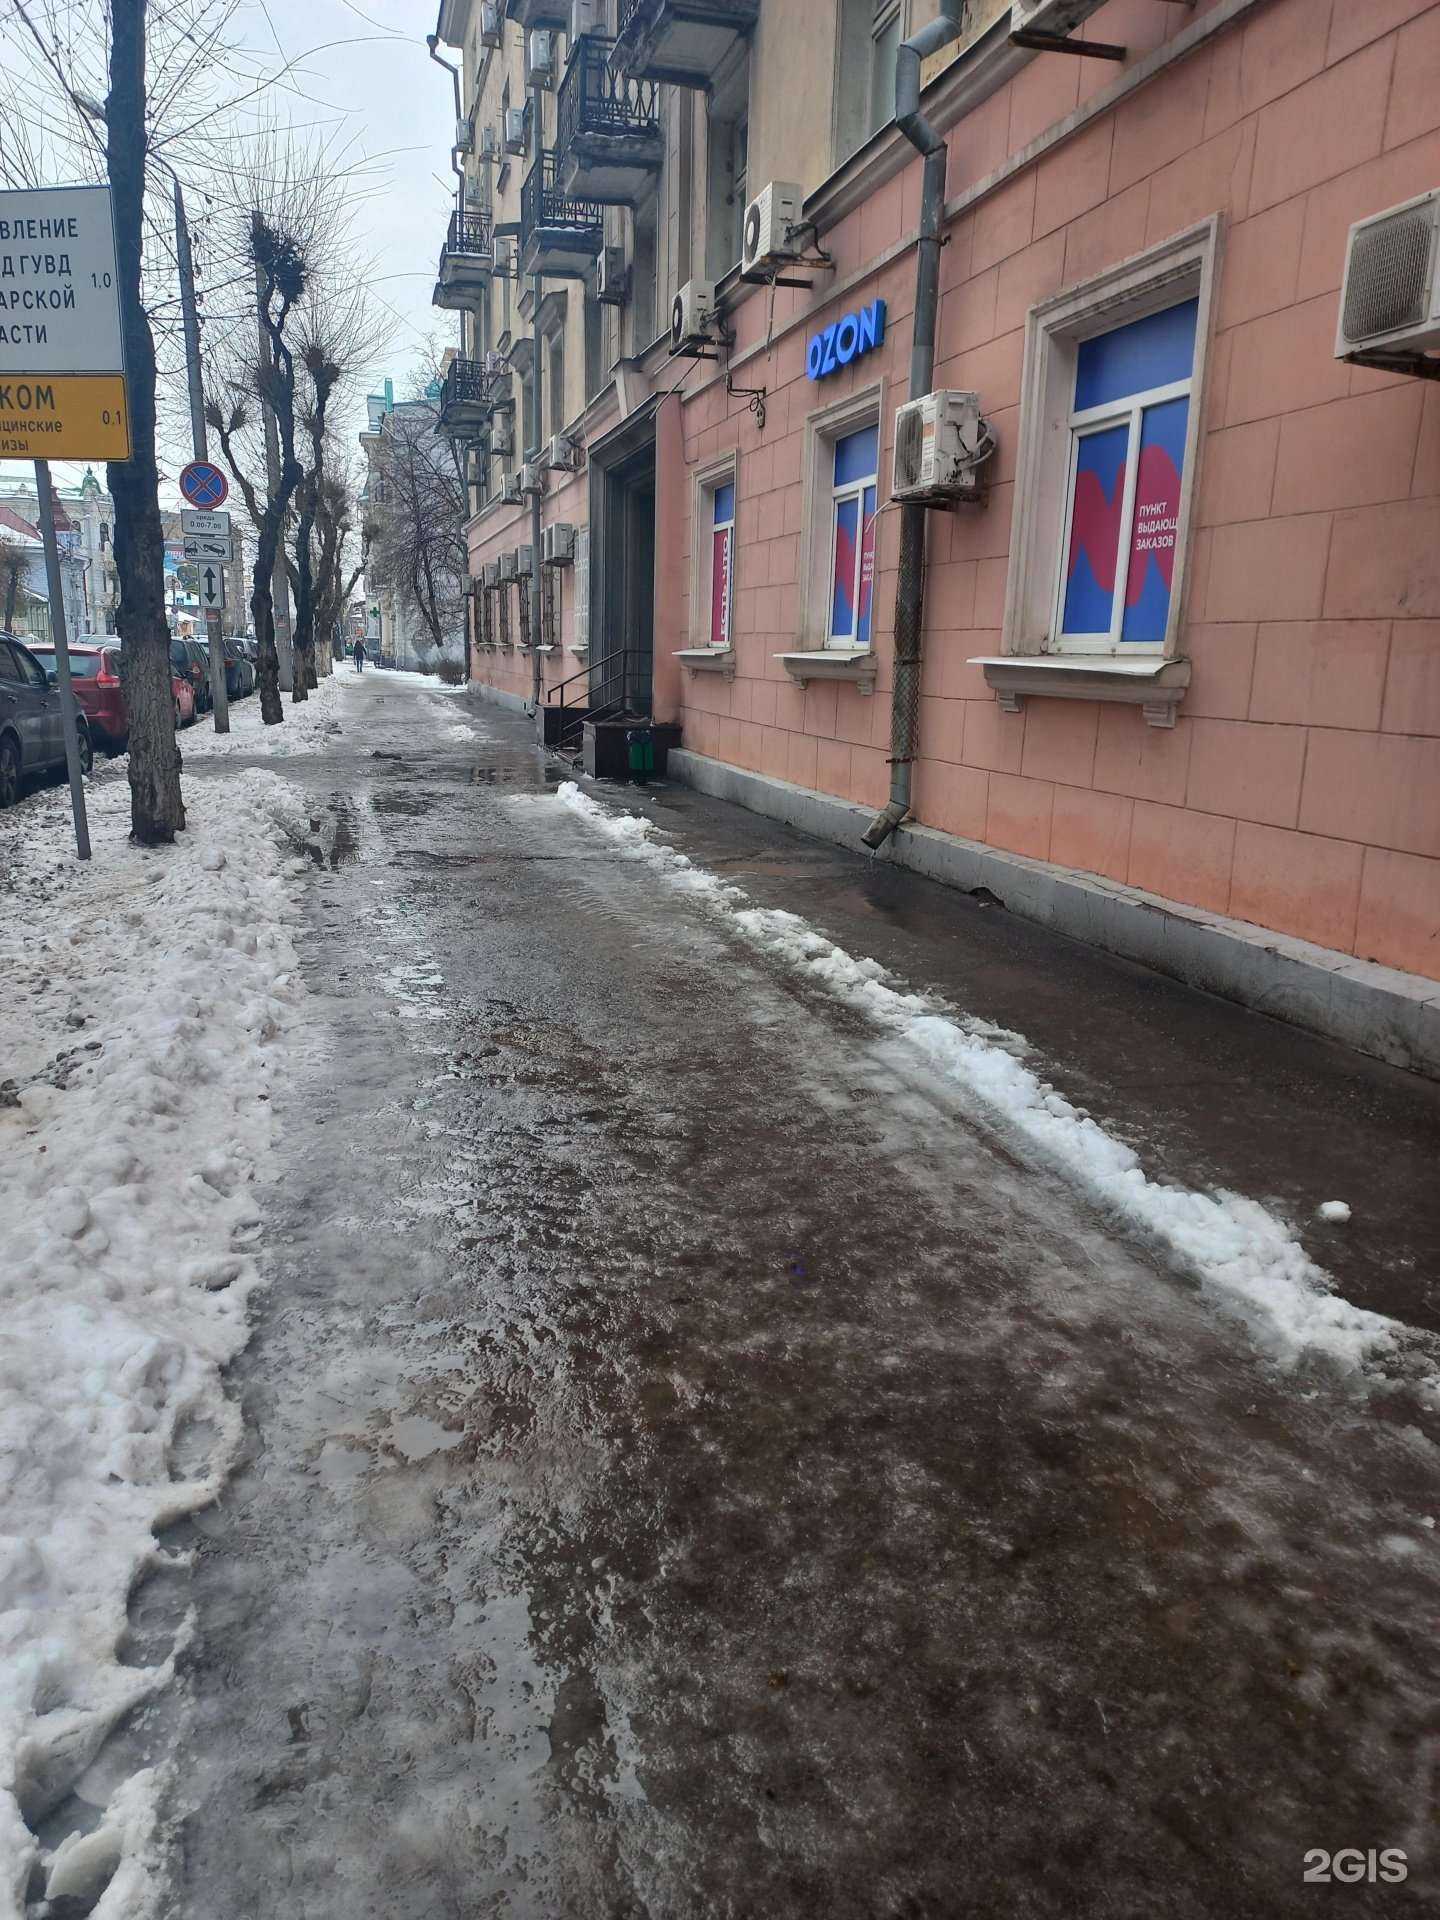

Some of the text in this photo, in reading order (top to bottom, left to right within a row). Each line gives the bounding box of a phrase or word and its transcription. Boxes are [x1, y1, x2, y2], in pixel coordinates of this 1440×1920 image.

[0, 218, 79, 240] ВЛЕНИЕ
[19, 254, 72, 277] ГУВД
[91, 272, 111, 288] 1.0
[807, 298, 887, 382] OZON
[102, 410, 121, 425] 0.1
[1139, 502, 1167, 517] ПУНКТ
[1136, 535, 1174, 551] ЗАКАЗОВ
